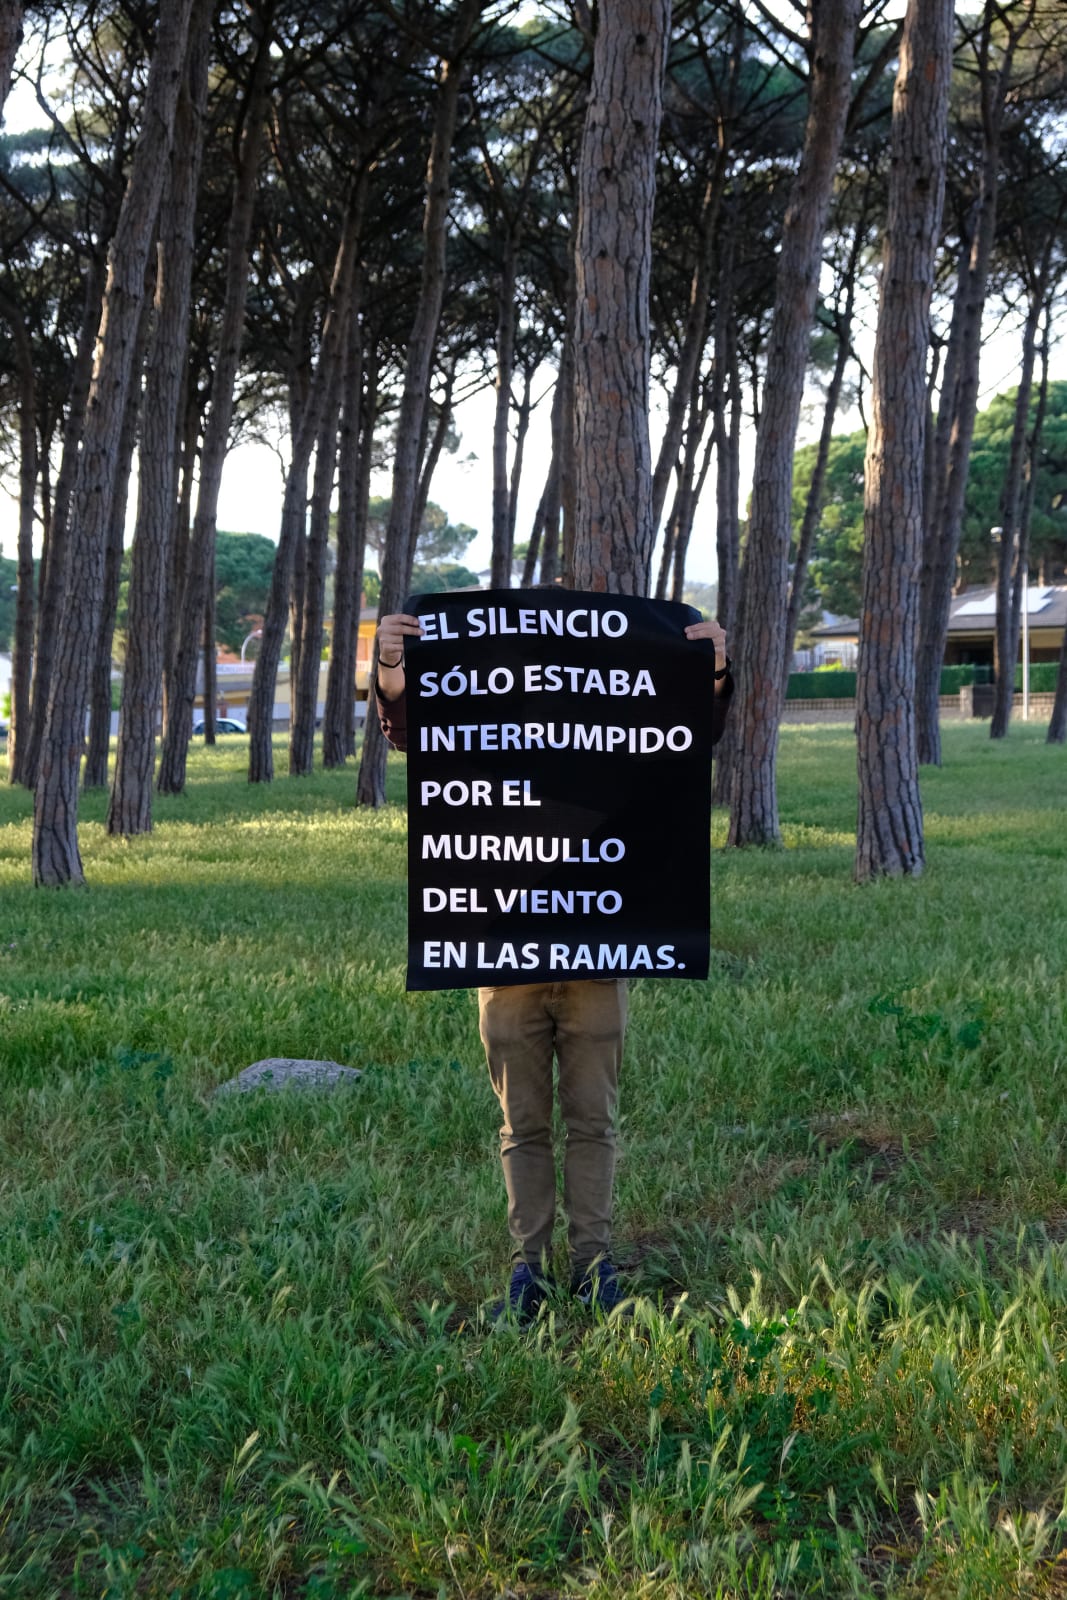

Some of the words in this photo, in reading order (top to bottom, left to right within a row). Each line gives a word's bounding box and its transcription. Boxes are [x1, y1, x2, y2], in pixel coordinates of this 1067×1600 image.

[418, 612, 459, 641] EL
[466, 607, 629, 638] SILENCIO
[419, 665, 514, 698] SÓLO
[523, 664, 657, 697] ESTABA
[420, 722, 693, 753] INTERRUMPIDO
[421, 780, 493, 807] POR
[502, 780, 542, 807] EL
[421, 834, 626, 863] MURMULLO
[422, 887, 488, 913] DEL
[493, 888, 623, 915] VIENTO
[422, 940, 467, 969] EN
[477, 941, 540, 970] LAS
[549, 943, 687, 971] RAMAS.
